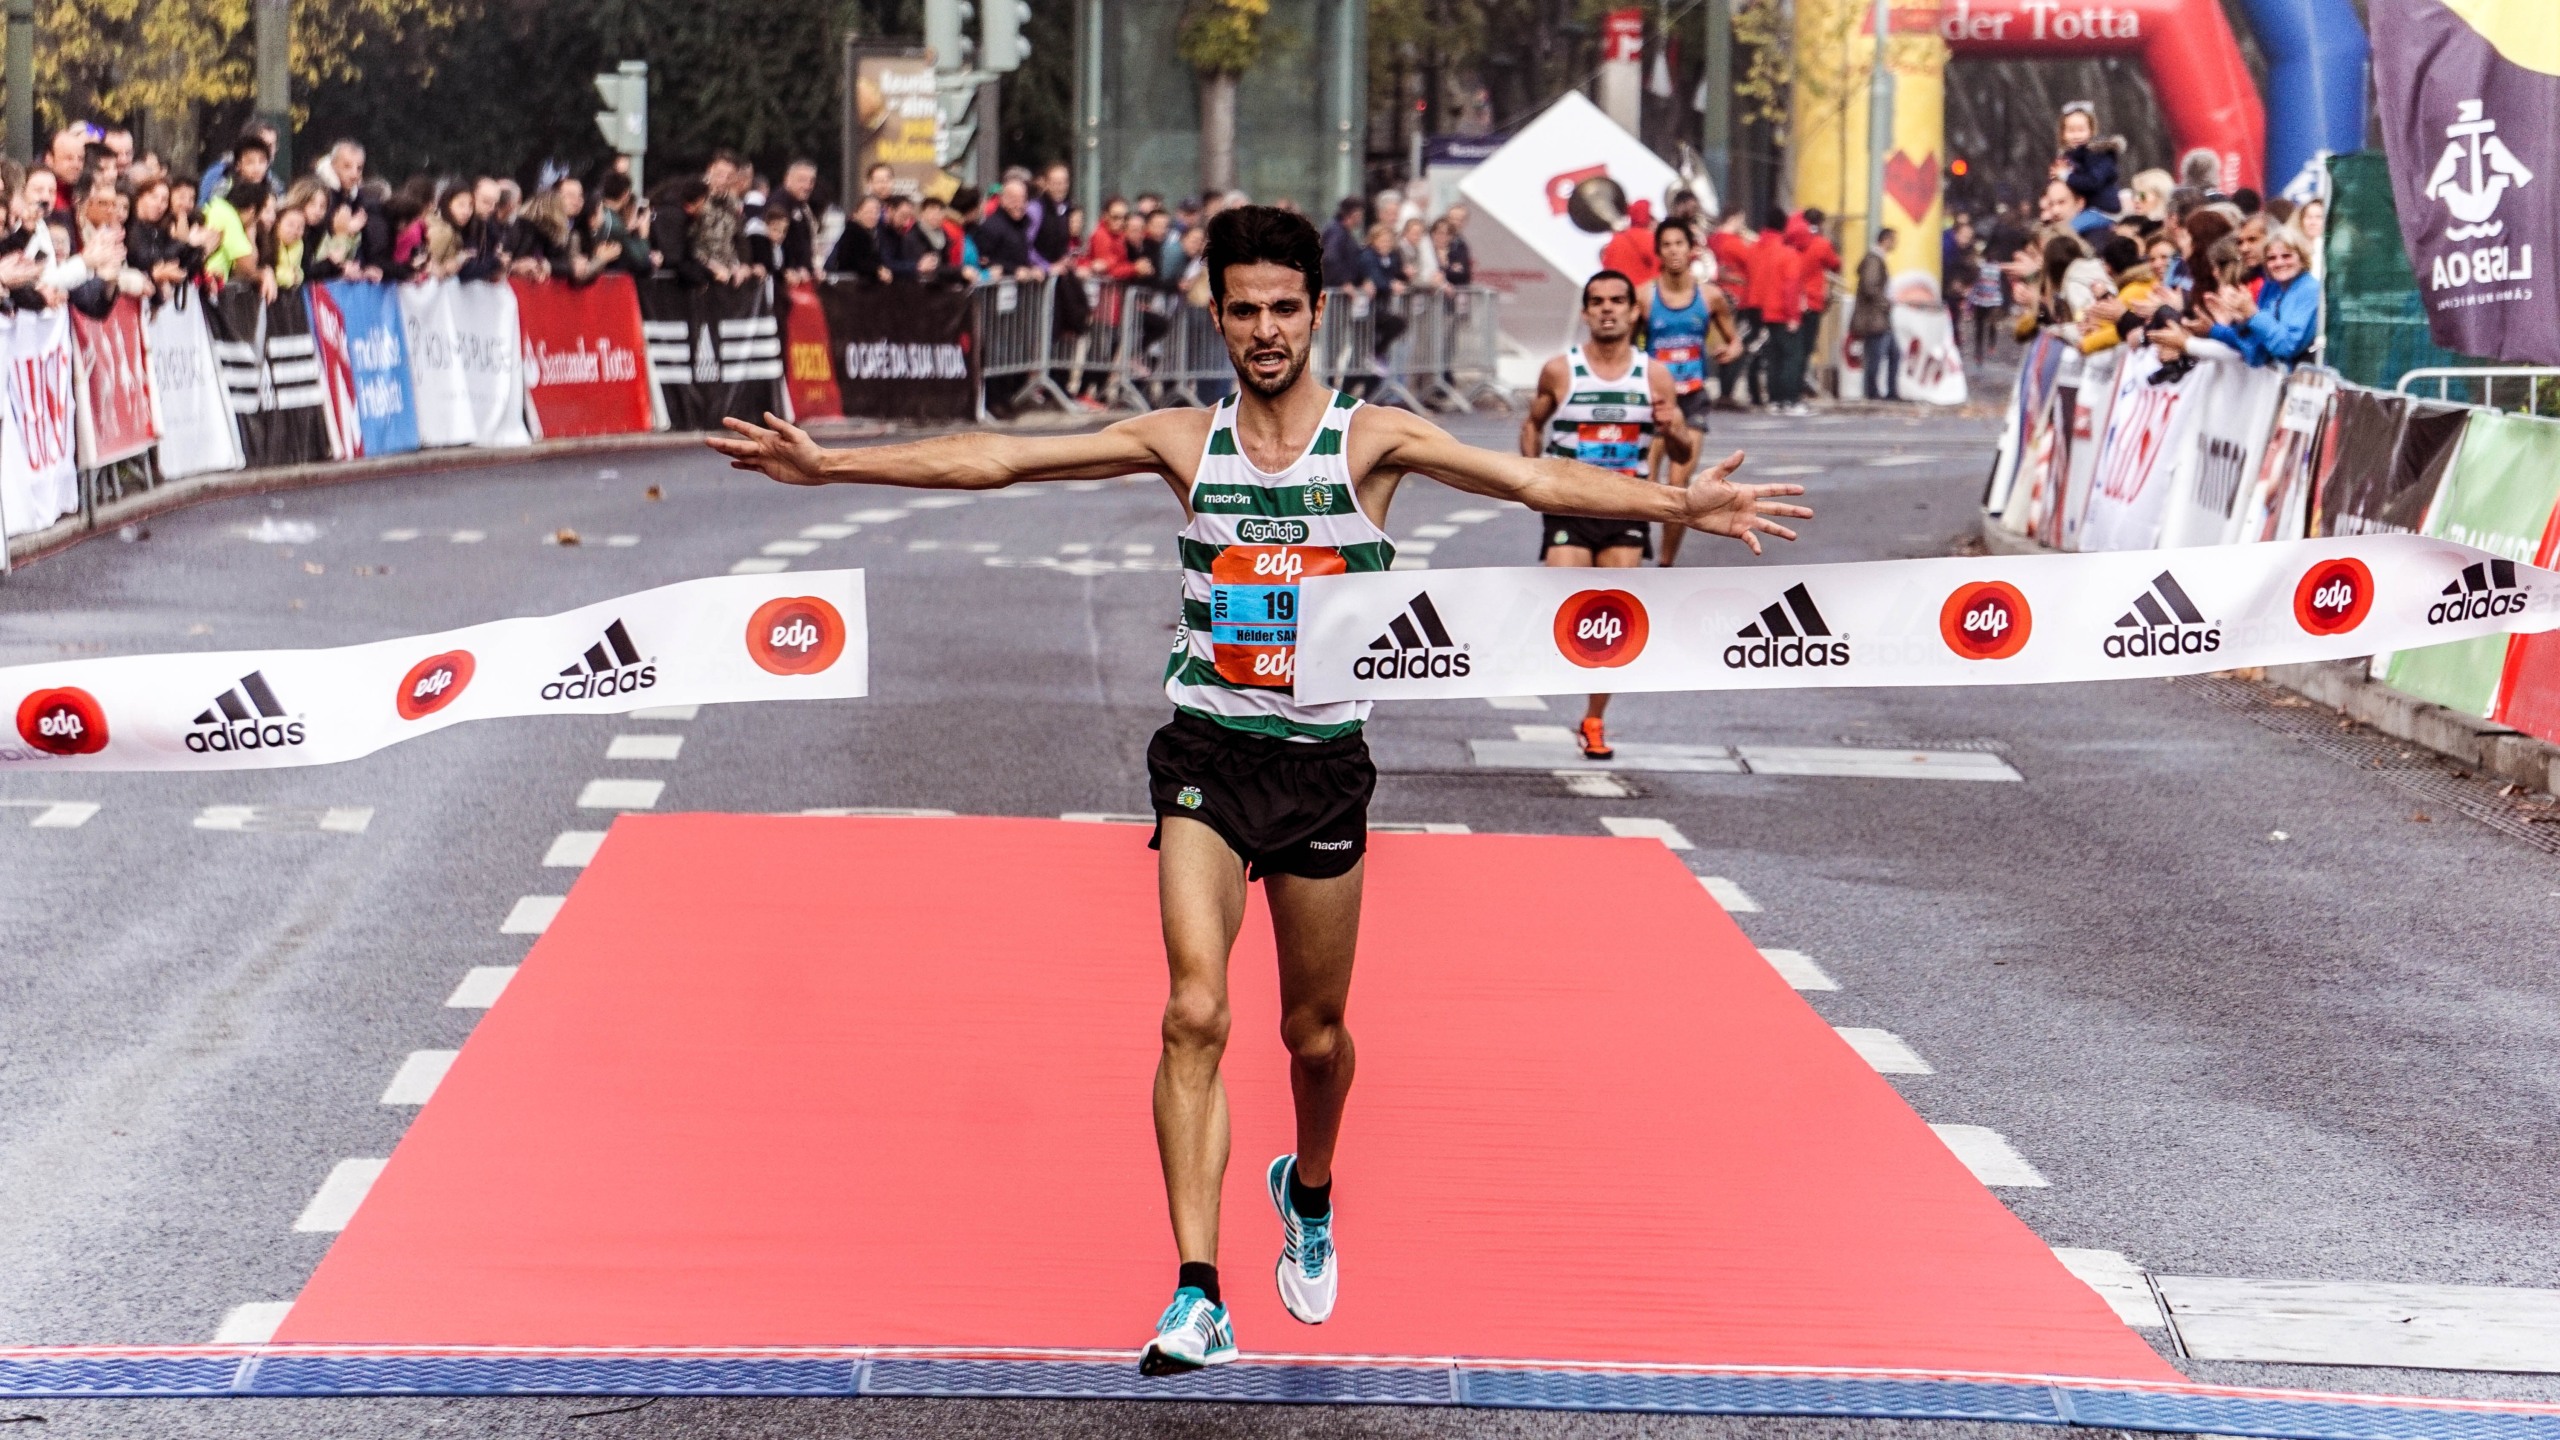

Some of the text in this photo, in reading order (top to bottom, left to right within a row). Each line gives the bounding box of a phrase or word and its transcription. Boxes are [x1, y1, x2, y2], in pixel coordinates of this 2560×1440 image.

[2020, 1, 2140, 40] Totta
[537, 336, 637, 386] Santander Totta
[845, 342, 859, 379] O
[935, 342, 968, 379] VIDA
[1308, 475, 1328, 483] SCP
[1203, 493, 1251, 505] macron
[1243, 521, 1302, 543] Agriloja
[1254, 547, 1303, 583] edp
[1214, 590, 1228, 619] 2017
[1263, 591, 1294, 620] 19
[1236, 630, 1275, 642] Hélder
[1353, 648, 1471, 681] adidas
[1576, 611, 1622, 645] edp
[1723, 636, 1850, 671] adidas
[1963, 602, 2009, 636] edp
[2103, 624, 2222, 659] adidas
[2313, 579, 2353, 613] edp
[2427, 589, 2528, 626] adidas
[38, 619, 819, 753] edp adidas edp adidas edp
[1309, 839, 1354, 850] macron
